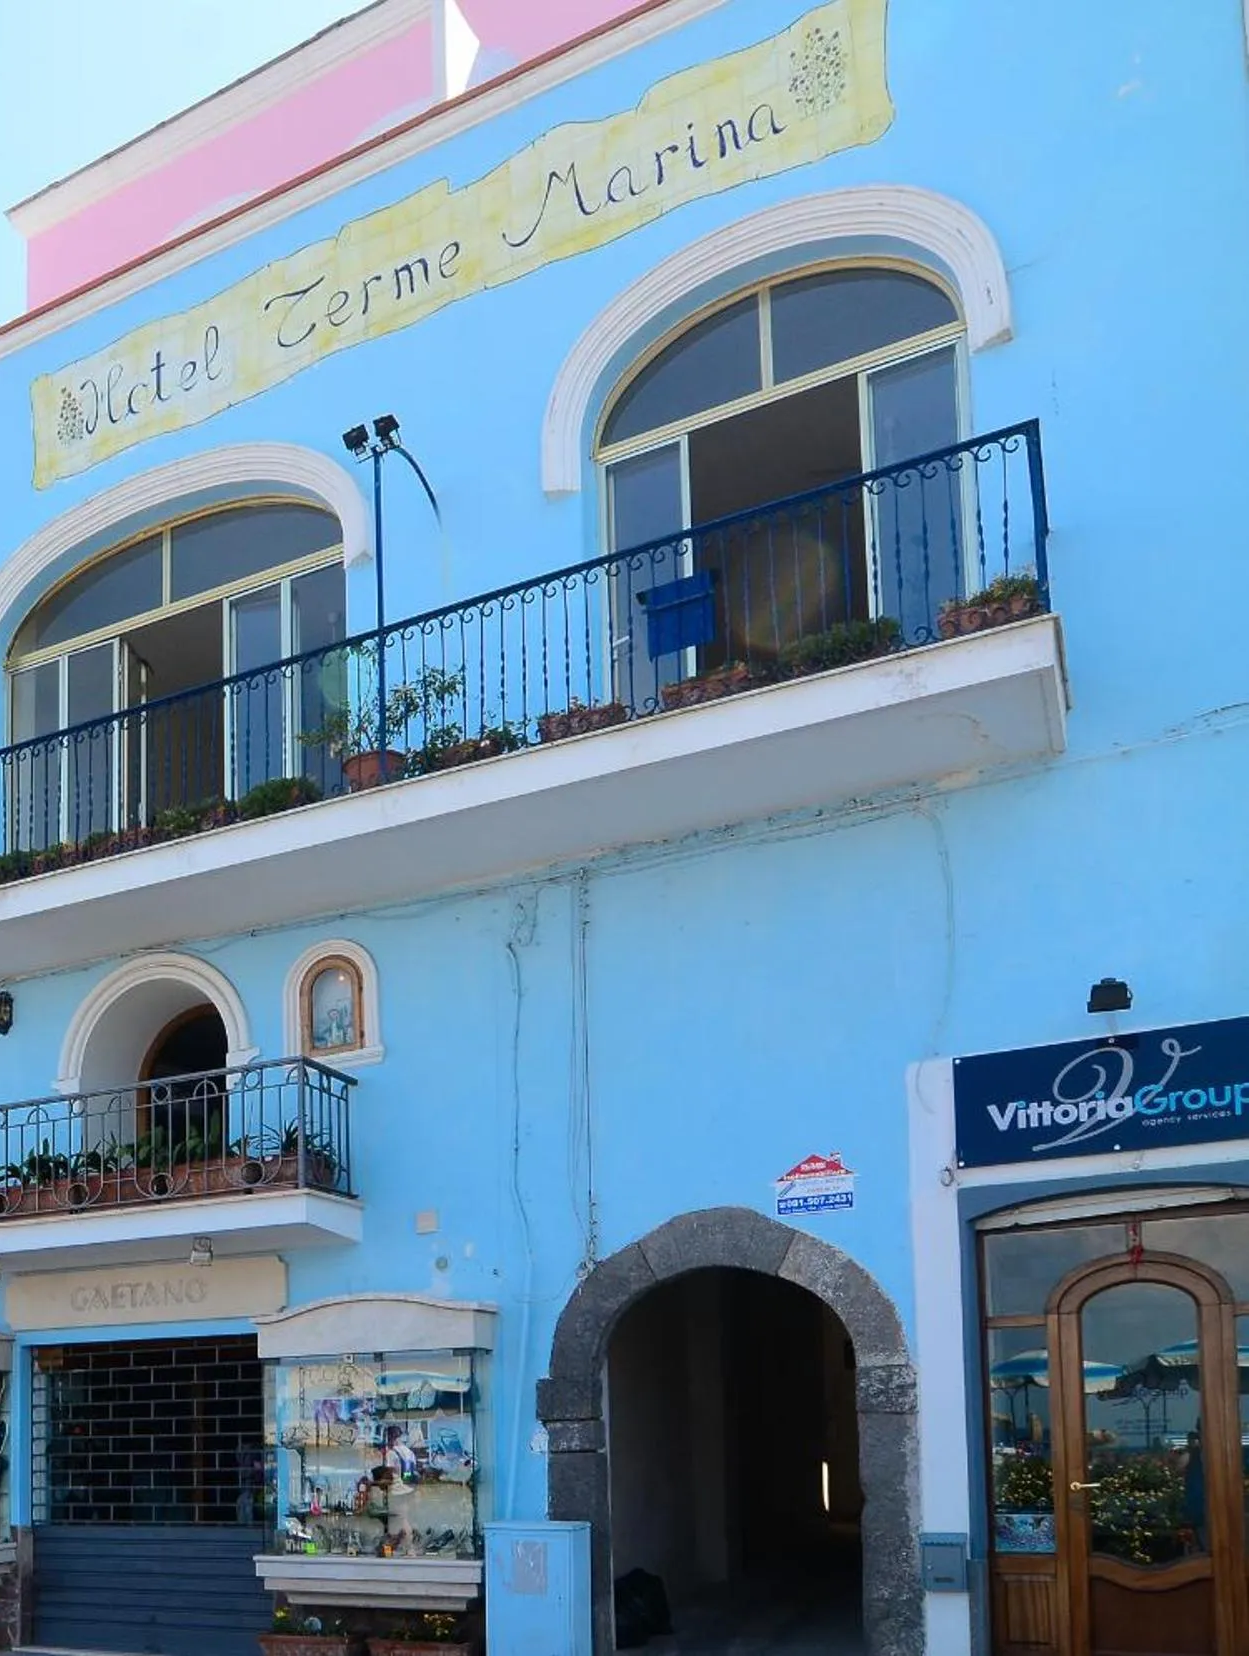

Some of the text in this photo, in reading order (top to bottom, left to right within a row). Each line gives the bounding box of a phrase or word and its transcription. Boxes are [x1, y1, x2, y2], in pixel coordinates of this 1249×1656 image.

[80, 104, 788, 434] Hotel Terme Marina
[1142, 1110, 1232, 1126] agency services
[71, 1278, 208, 1312] GAETANO
